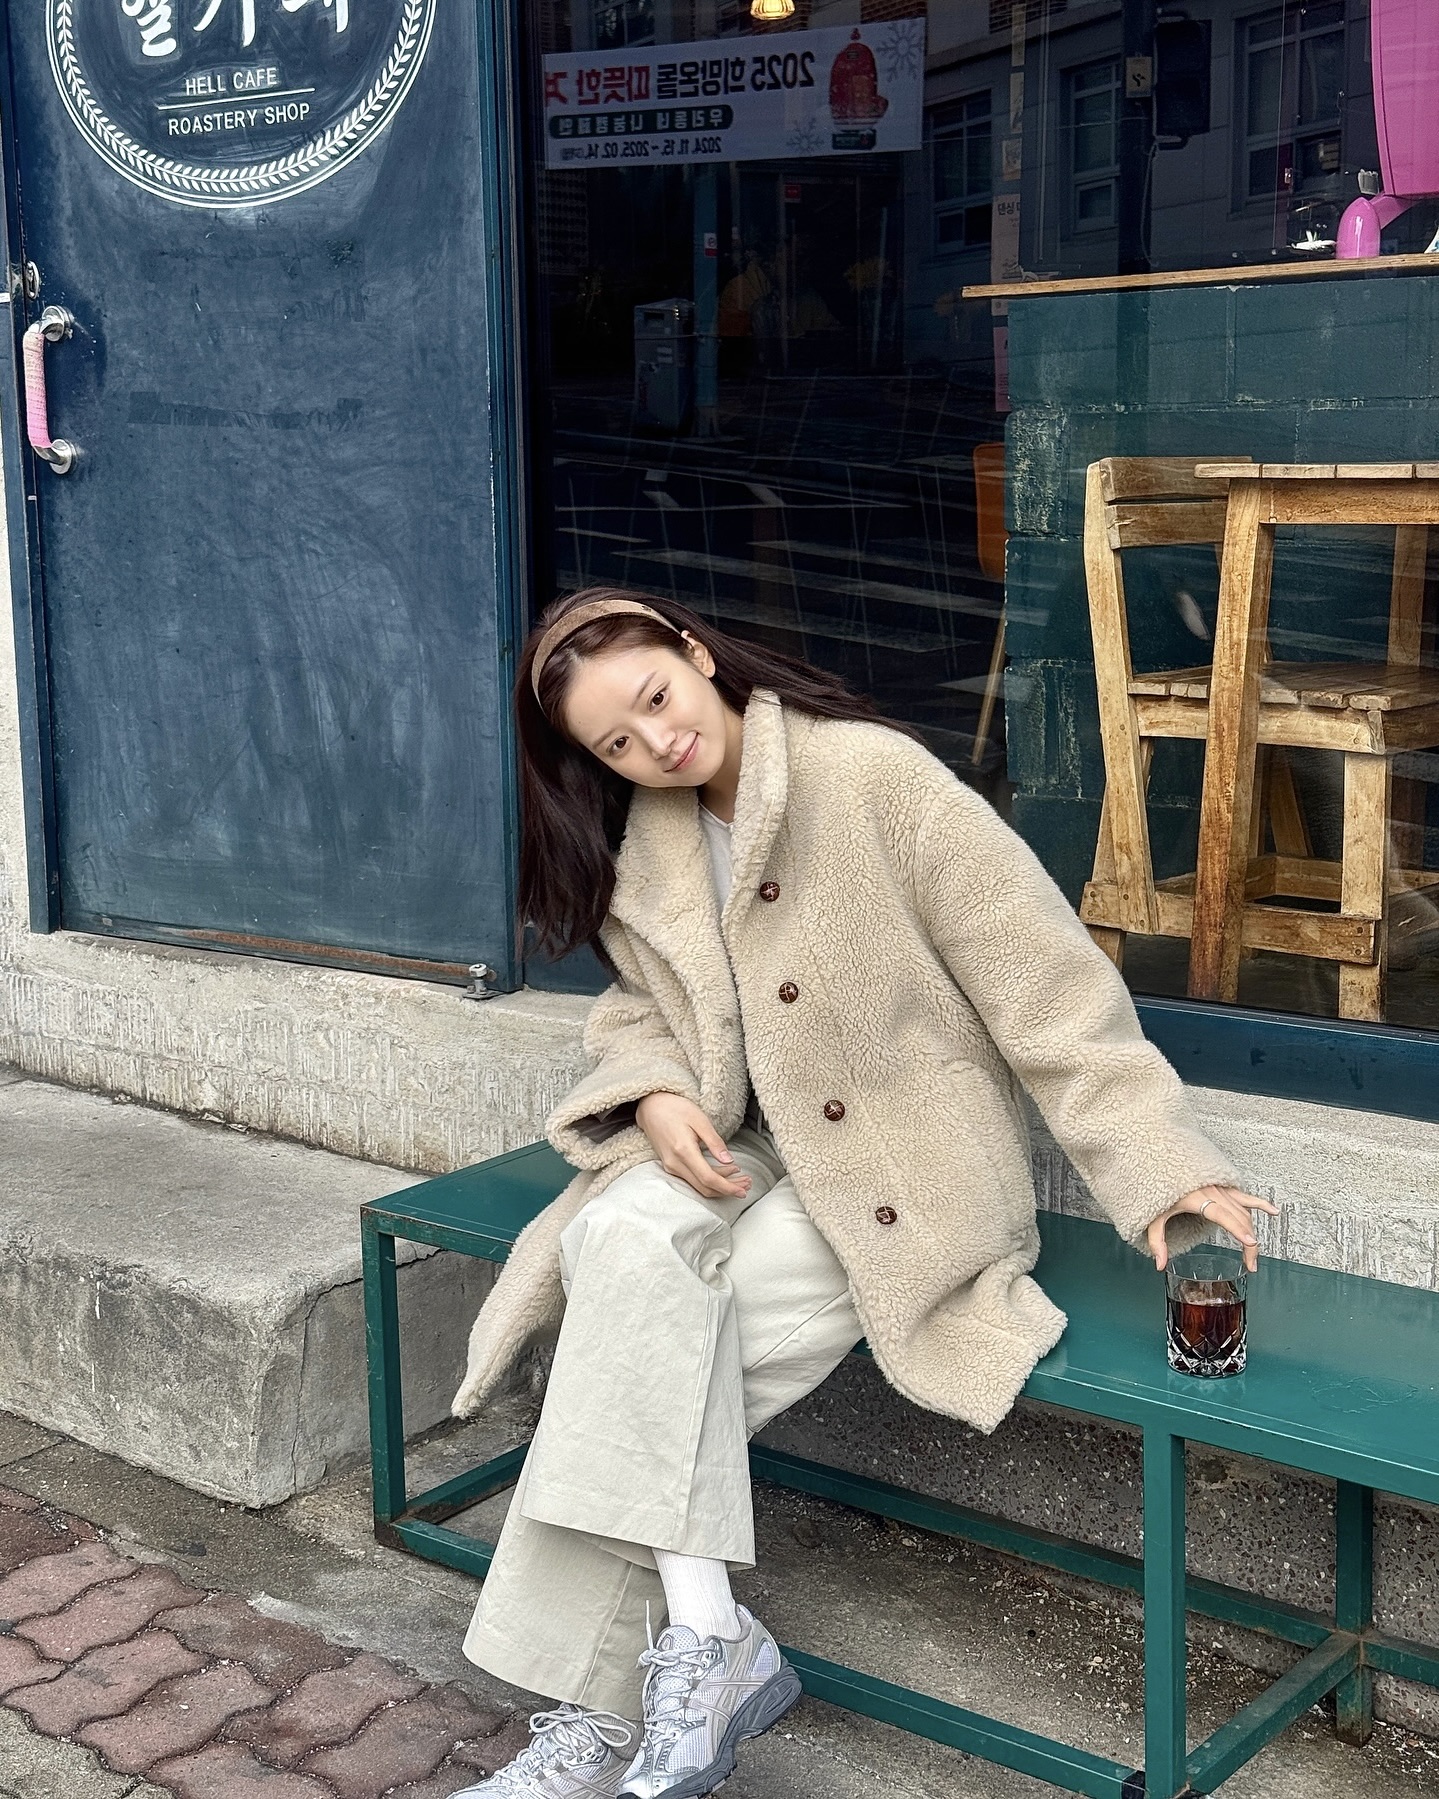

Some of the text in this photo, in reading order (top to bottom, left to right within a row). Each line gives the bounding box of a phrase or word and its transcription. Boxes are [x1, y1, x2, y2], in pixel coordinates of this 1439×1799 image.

[185, 66, 277, 97] HELL CAFE
[168, 102, 311, 136] ROASTERY SHOP
